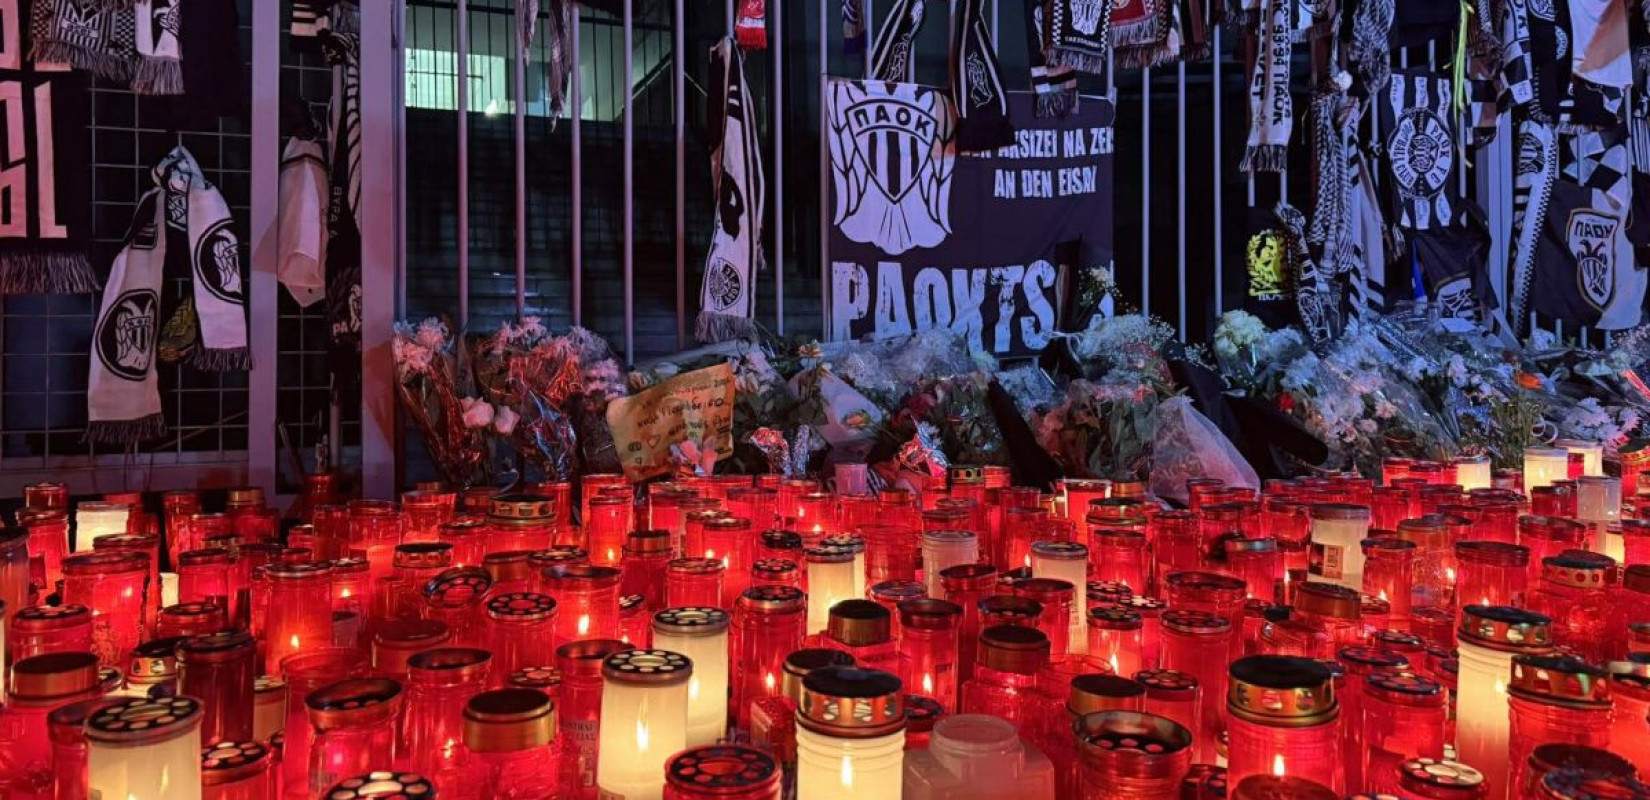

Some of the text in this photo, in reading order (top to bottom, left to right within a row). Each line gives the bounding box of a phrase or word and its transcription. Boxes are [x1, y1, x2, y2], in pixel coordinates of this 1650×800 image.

[854, 104, 932, 137] ΠΑΟΚ
[1063, 128, 1087, 158] NA
[994, 169, 1016, 198] AN
[1022, 168, 1053, 198] DEN
